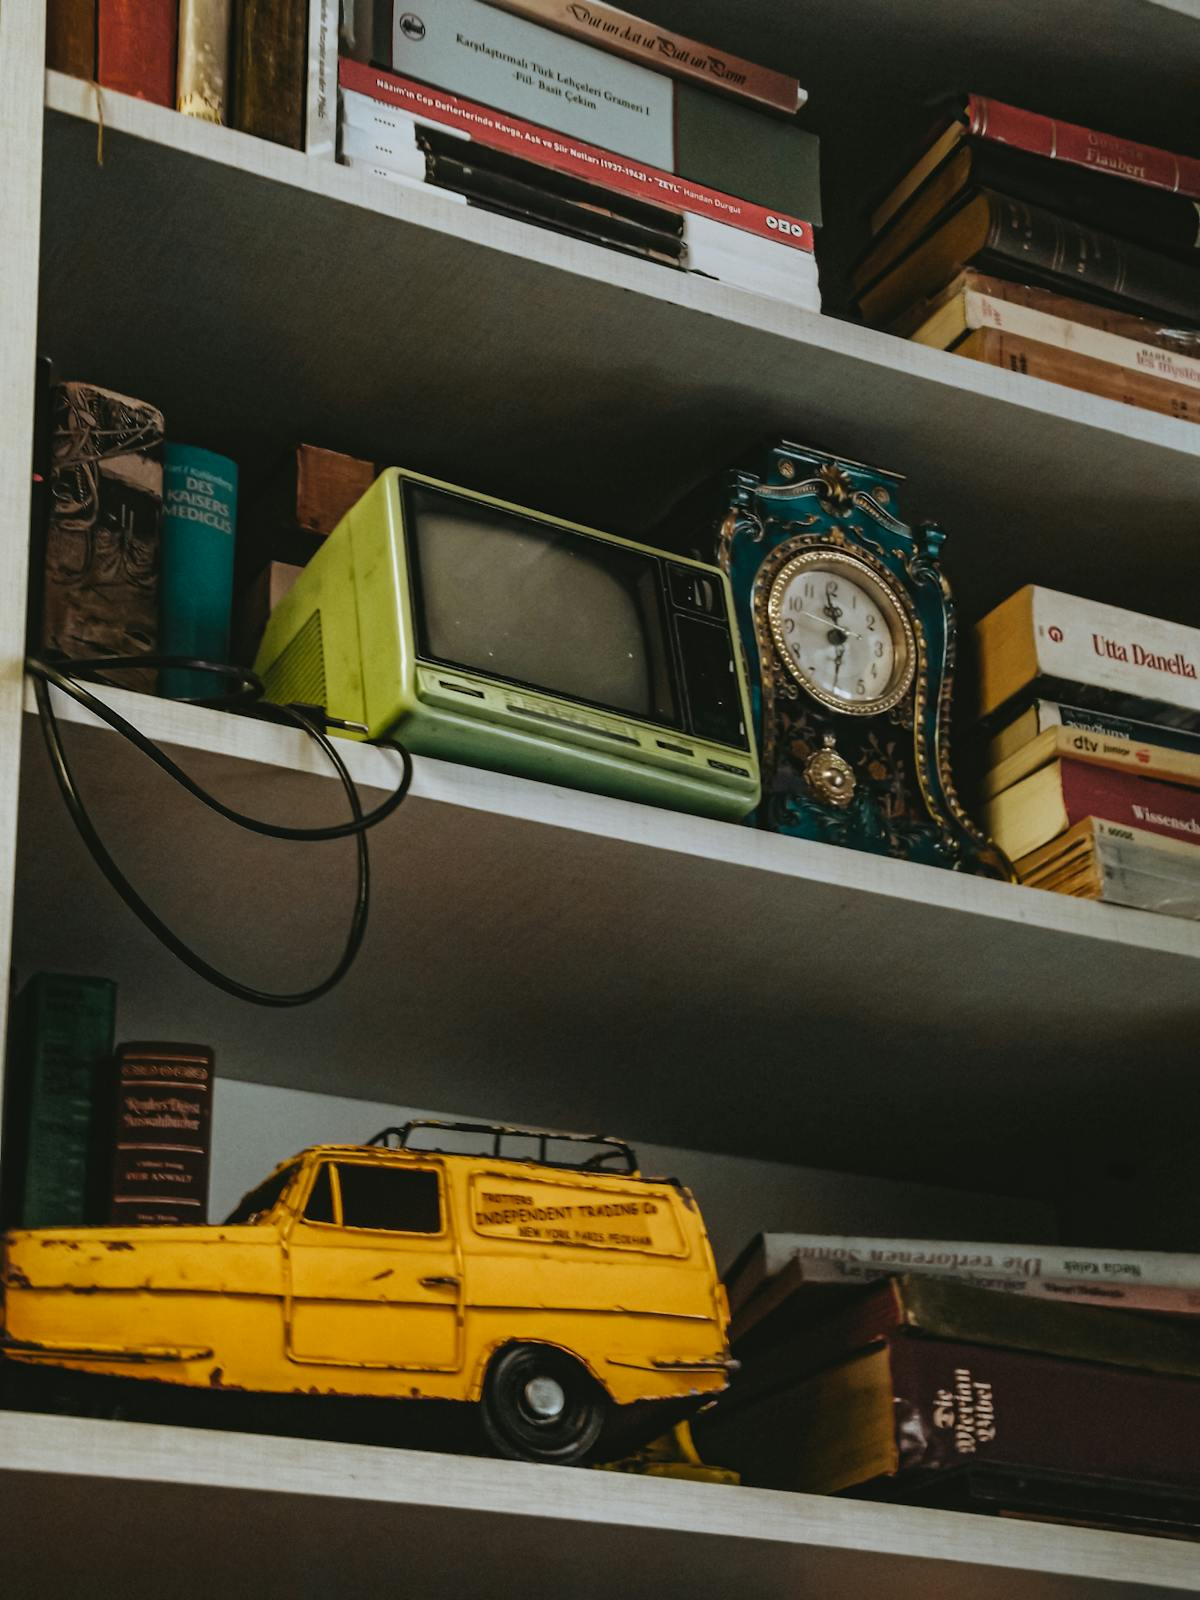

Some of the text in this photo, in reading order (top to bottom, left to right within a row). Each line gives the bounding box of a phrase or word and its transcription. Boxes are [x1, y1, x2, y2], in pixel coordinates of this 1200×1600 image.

[456, 33, 528, 69] Karşılaştırmalı
[530, 62, 554, 80] Türk
[557, 72, 601, 97] Lehçeleri
[604, 91, 643, 114] Grameri
[538, 80, 562, 96] Basit
[565, 91, 597, 110] Çekim
[417, 92, 434, 107] Cep
[435, 100, 493, 128] Defterlerinde
[495, 122, 523, 139] Kavga,
[524, 132, 541, 145] Aşk
[542, 139, 553, 149] ve
[554, 142, 569, 154] Şiir
[570, 148, 600, 165] Notları
[600, 158, 647, 182] (1937-1942)
[683, 187, 713, 205] Handan
[714, 199, 742, 215] Durgut
[1086, 148, 1145, 177] Flaubert
[186, 476, 214, 495] DES
[168, 489, 229, 518] KAISERS
[162, 505, 232, 534] MEDICUS
[805, 583, 814, 598] 11
[789, 597, 803, 611] 10
[867, 614, 875, 631] 2
[791, 642, 800, 659] 8
[875, 641, 883, 658] 3
[1092, 634, 1197, 679] Utta Danella
[871, 663, 877, 678] 4
[857, 678, 865, 695] 5
[1074, 736, 1098, 752] dtv
[475, 1205, 573, 1225] INDEPENDENT
[578, 1202, 639, 1217] TRADING
[519, 1226, 541, 1237] NEW
[545, 1229, 570, 1240] YORK
[574, 1231, 604, 1243] PARIS
[933, 1389, 955, 1428] Die
[973, 1382, 996, 1442] Bibel
